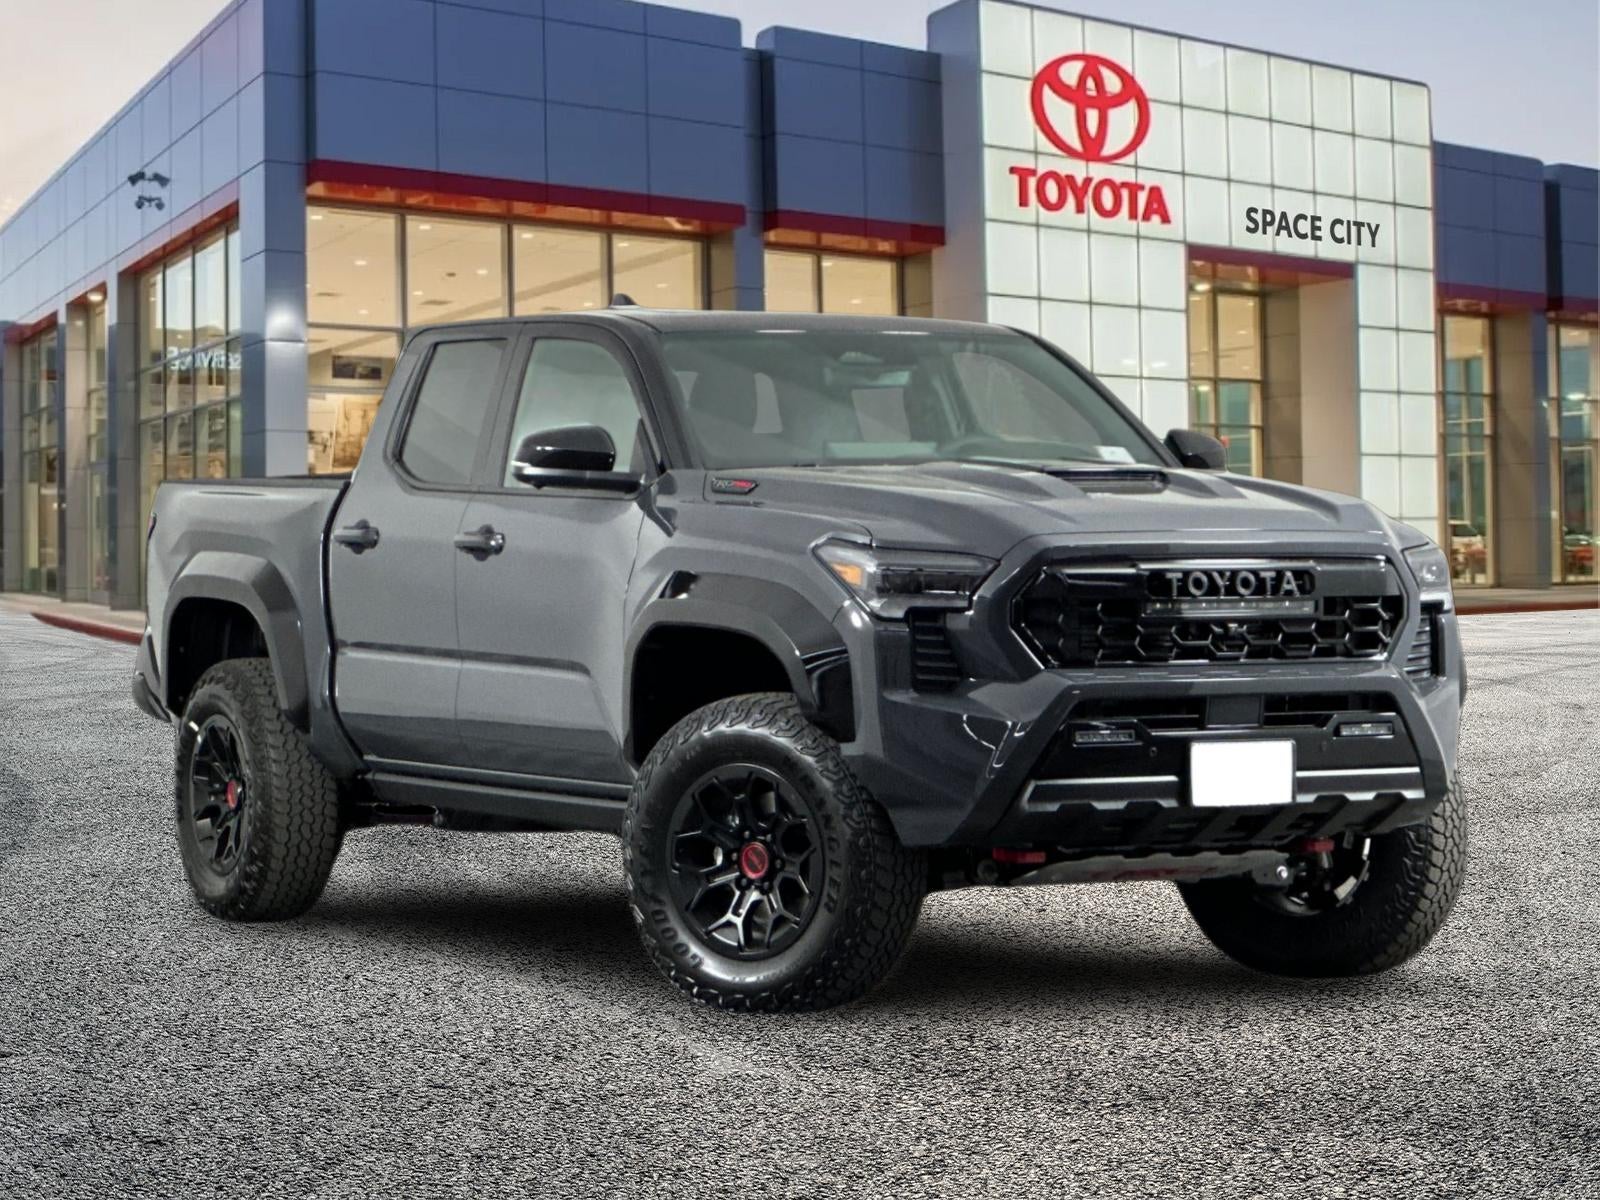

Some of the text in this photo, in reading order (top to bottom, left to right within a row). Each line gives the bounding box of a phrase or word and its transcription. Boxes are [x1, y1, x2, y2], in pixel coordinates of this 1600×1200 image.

[1009, 166, 1171, 224] TOYOTA
[1245, 206, 1381, 248] SPACE CITY
[1165, 570, 1301, 599] TOYOTA
